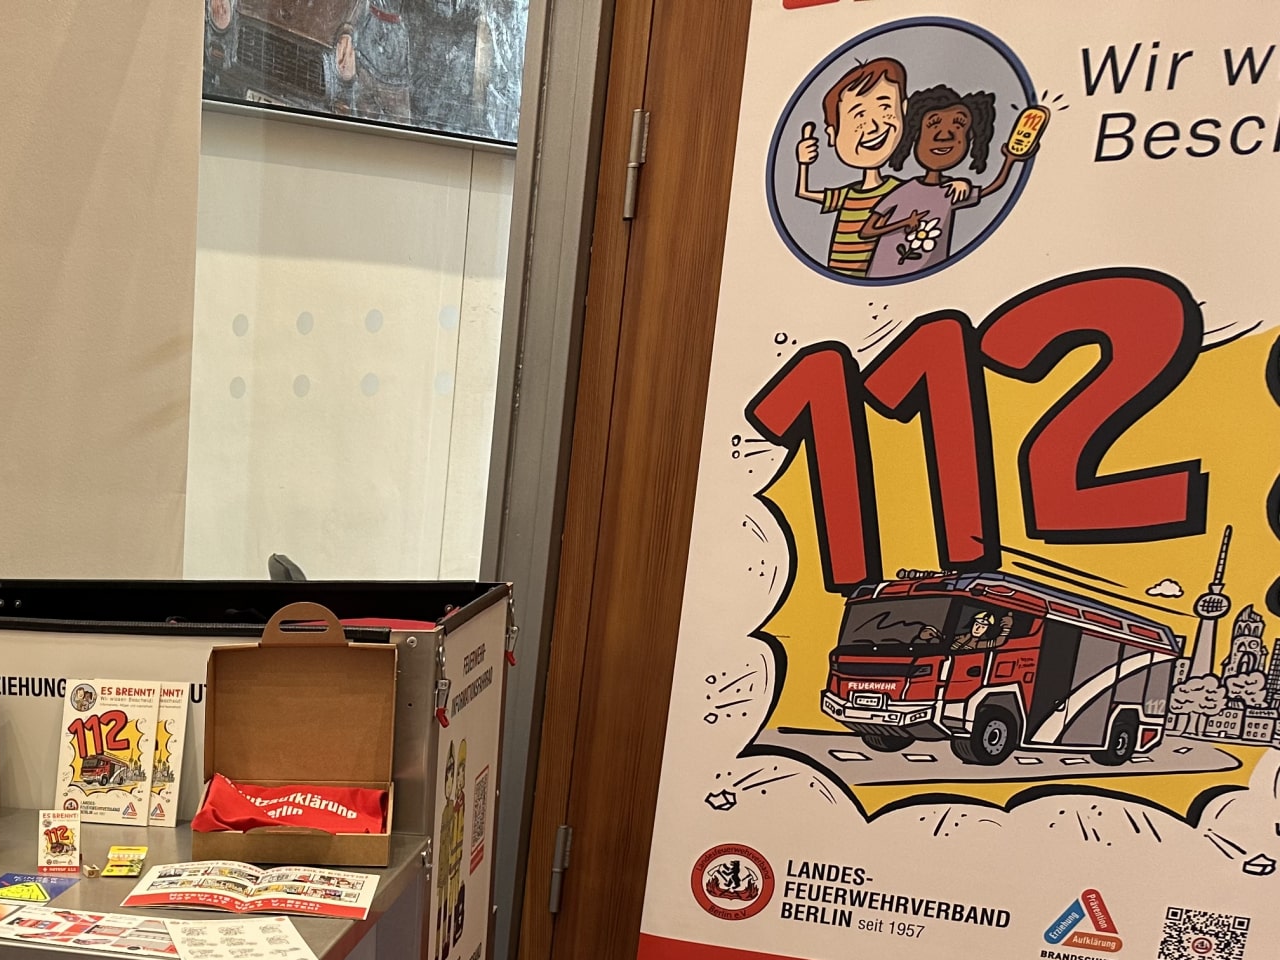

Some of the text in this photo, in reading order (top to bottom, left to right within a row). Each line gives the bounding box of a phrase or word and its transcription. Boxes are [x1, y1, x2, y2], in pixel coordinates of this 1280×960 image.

[1081, 41, 1194, 96] Wir
[1023, 112, 1043, 131] 112
[745, 267, 1210, 597] 112
[100, 687, 156, 698] ES BRENNT!
[160, 688, 184, 698] NNT!
[847, 681, 897, 692] FEUERWEHR
[67, 709, 131, 758] 112
[266, 805, 304, 819] erlin
[44, 825, 70, 845] 112
[696, 846, 771, 879] Landesfeuerwehrverband
[786, 859, 874, 886] LANDES-
[708, 904, 732, 918] Berlin
[783, 881, 1011, 929] FEUERWEHRVERBAND
[1086, 893, 1109, 930] Prävention
[780, 902, 925, 939] BERLIN seit 1957
[1049, 910, 1080, 940] Erziehung
[1072, 934, 1117, 950] Aufklärung
